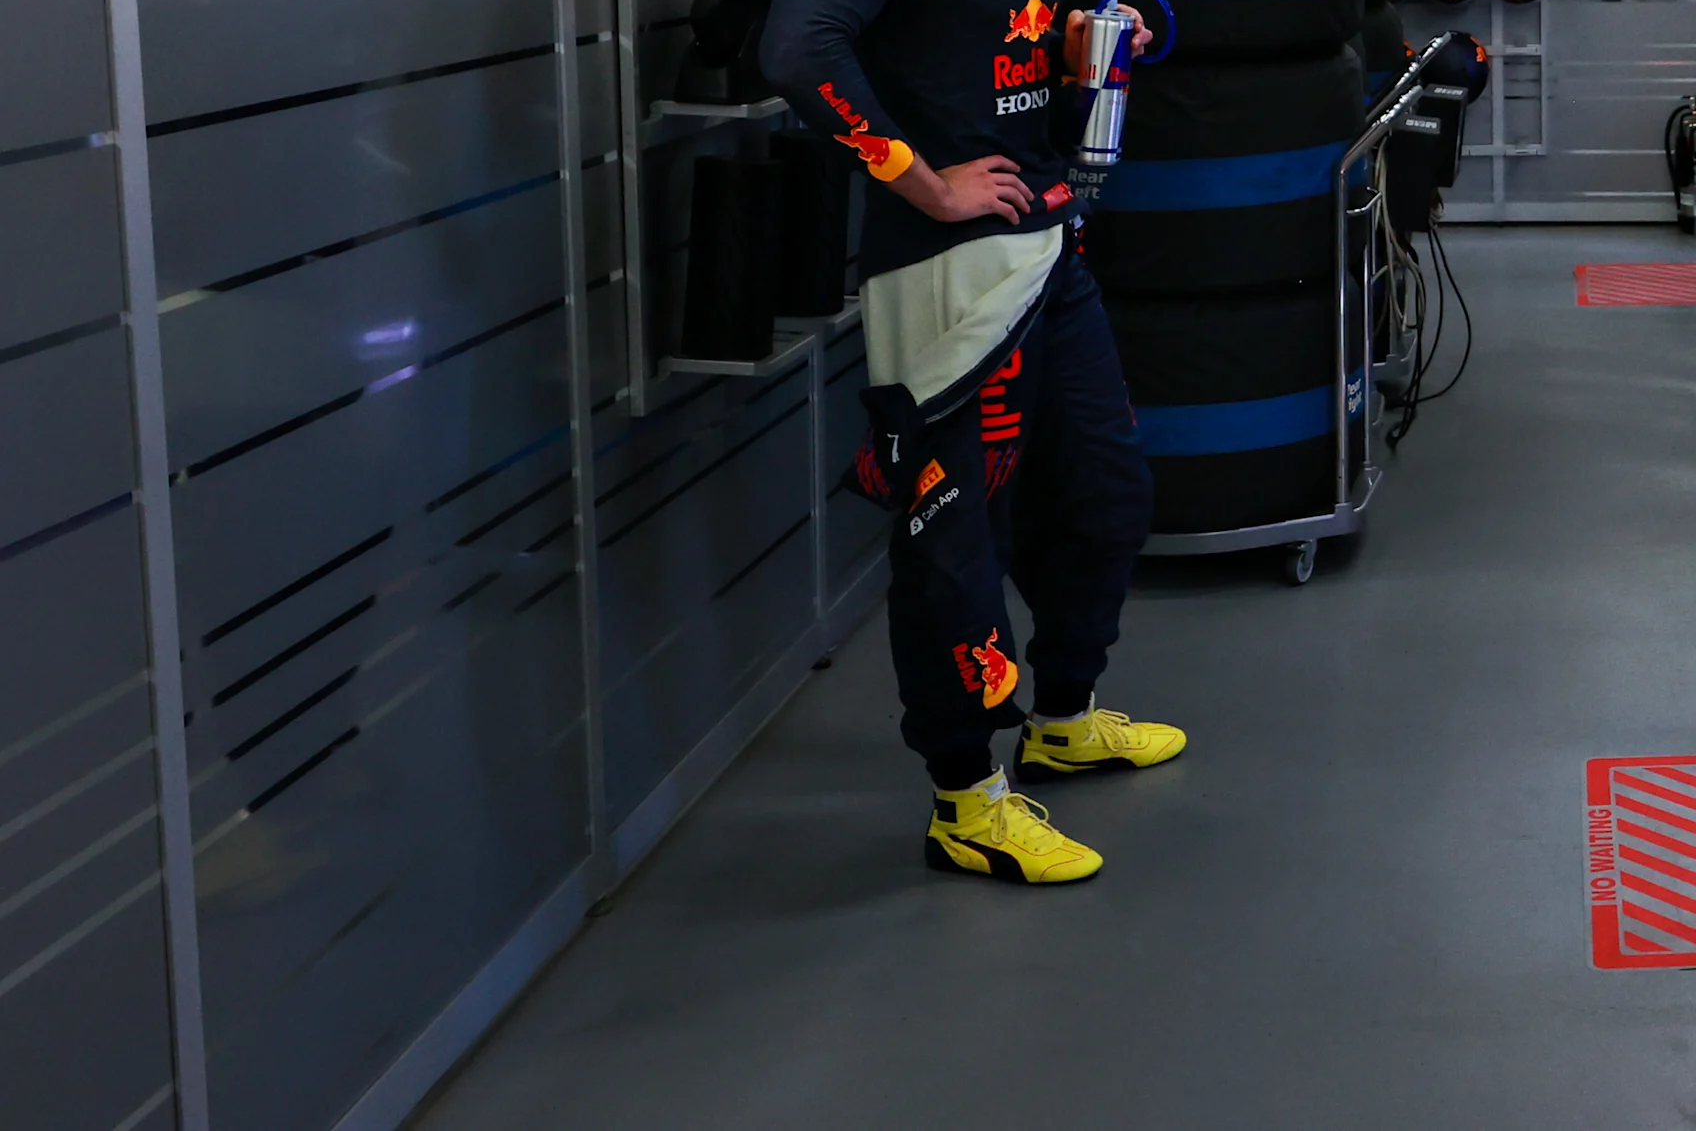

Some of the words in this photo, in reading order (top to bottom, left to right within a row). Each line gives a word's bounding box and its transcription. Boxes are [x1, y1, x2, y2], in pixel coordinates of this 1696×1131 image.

[1068, 168, 1108, 184] Rear
[921, 503, 940, 521] Cash
[938, 487, 960, 507] App
[1588, 809, 1615, 873] WAITING
[1590, 877, 1617, 901] NO
